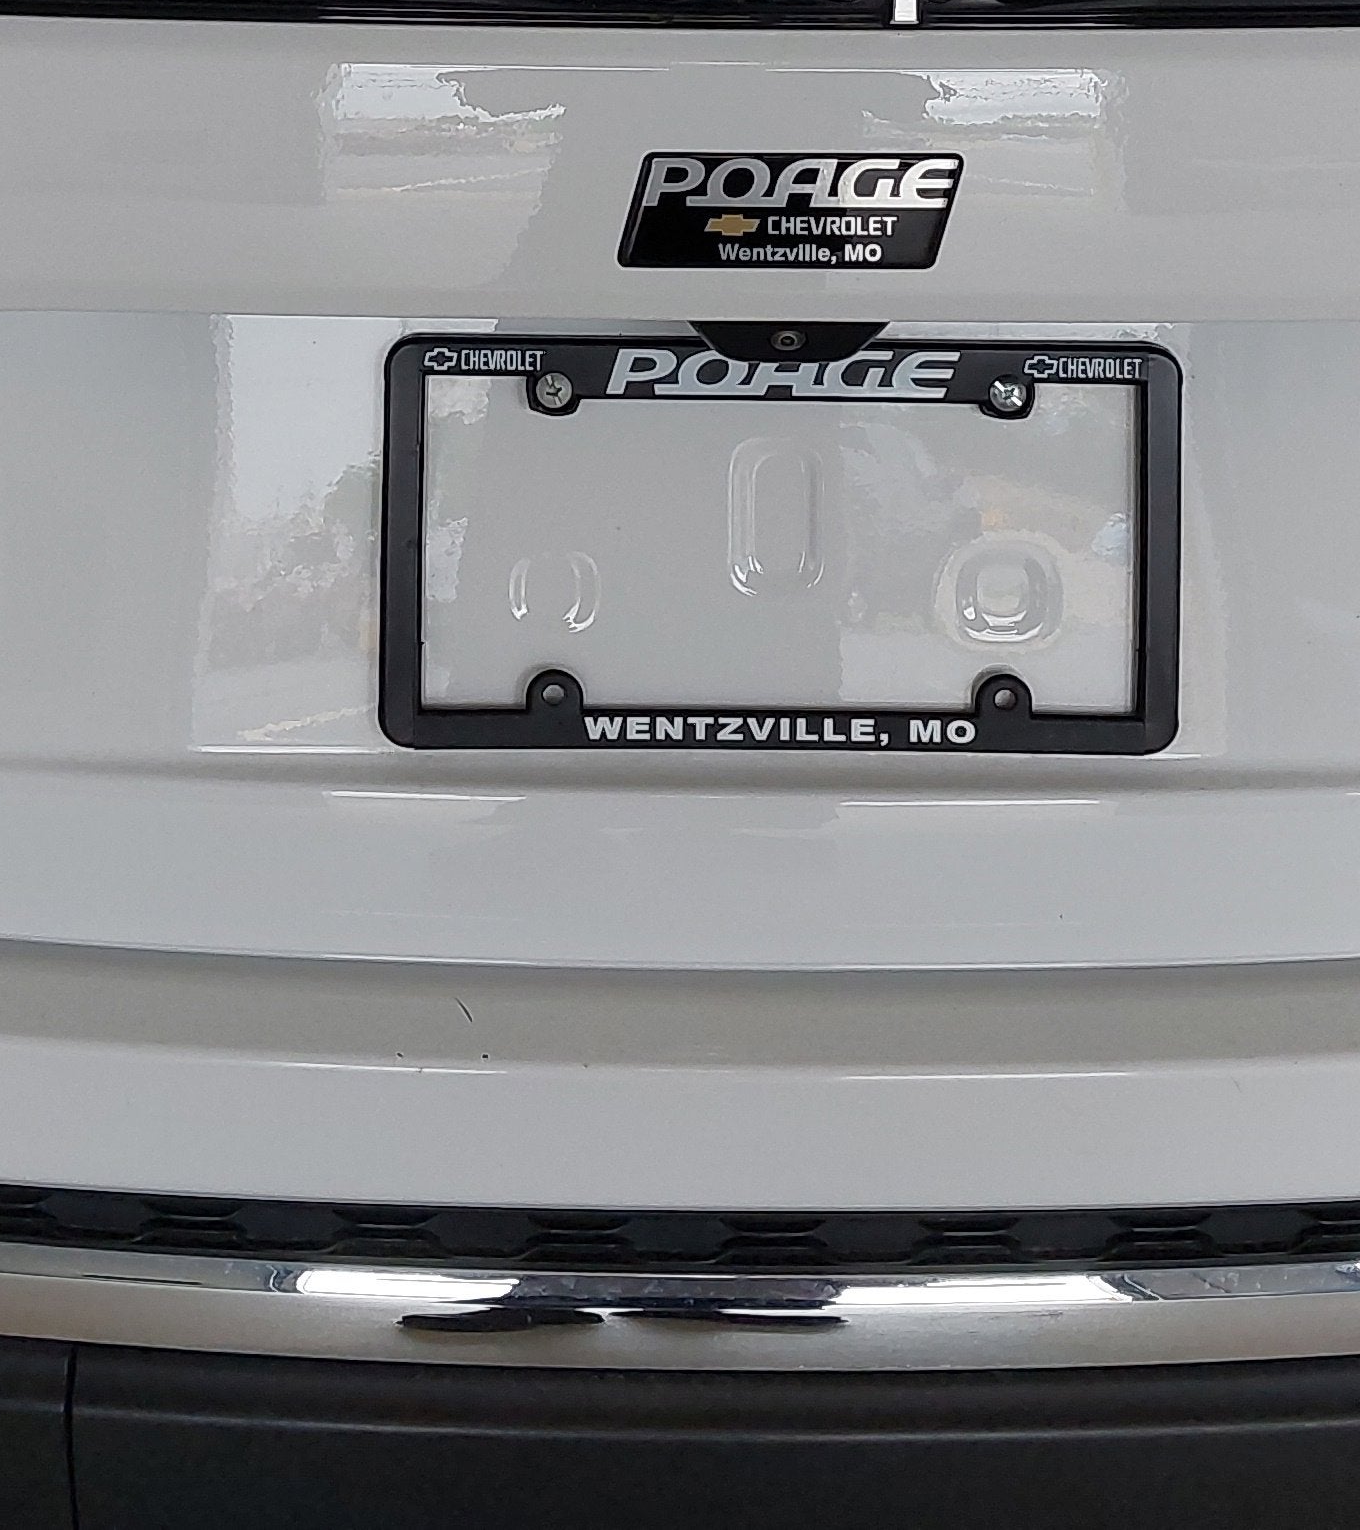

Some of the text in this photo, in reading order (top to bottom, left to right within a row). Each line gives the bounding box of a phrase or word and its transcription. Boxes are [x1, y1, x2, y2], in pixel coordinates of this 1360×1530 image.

[643, 157, 960, 208] POAGE
[766, 215, 899, 237] CHEVROLET
[717, 242, 883, 265] Wentzville, MO
[460, 349, 543, 371] CHEVROLET
[1056, 357, 1143, 379] CHEVROLET
[605, 348, 961, 399] POAGE
[583, 715, 977, 747] WENTZVILLE, MO
